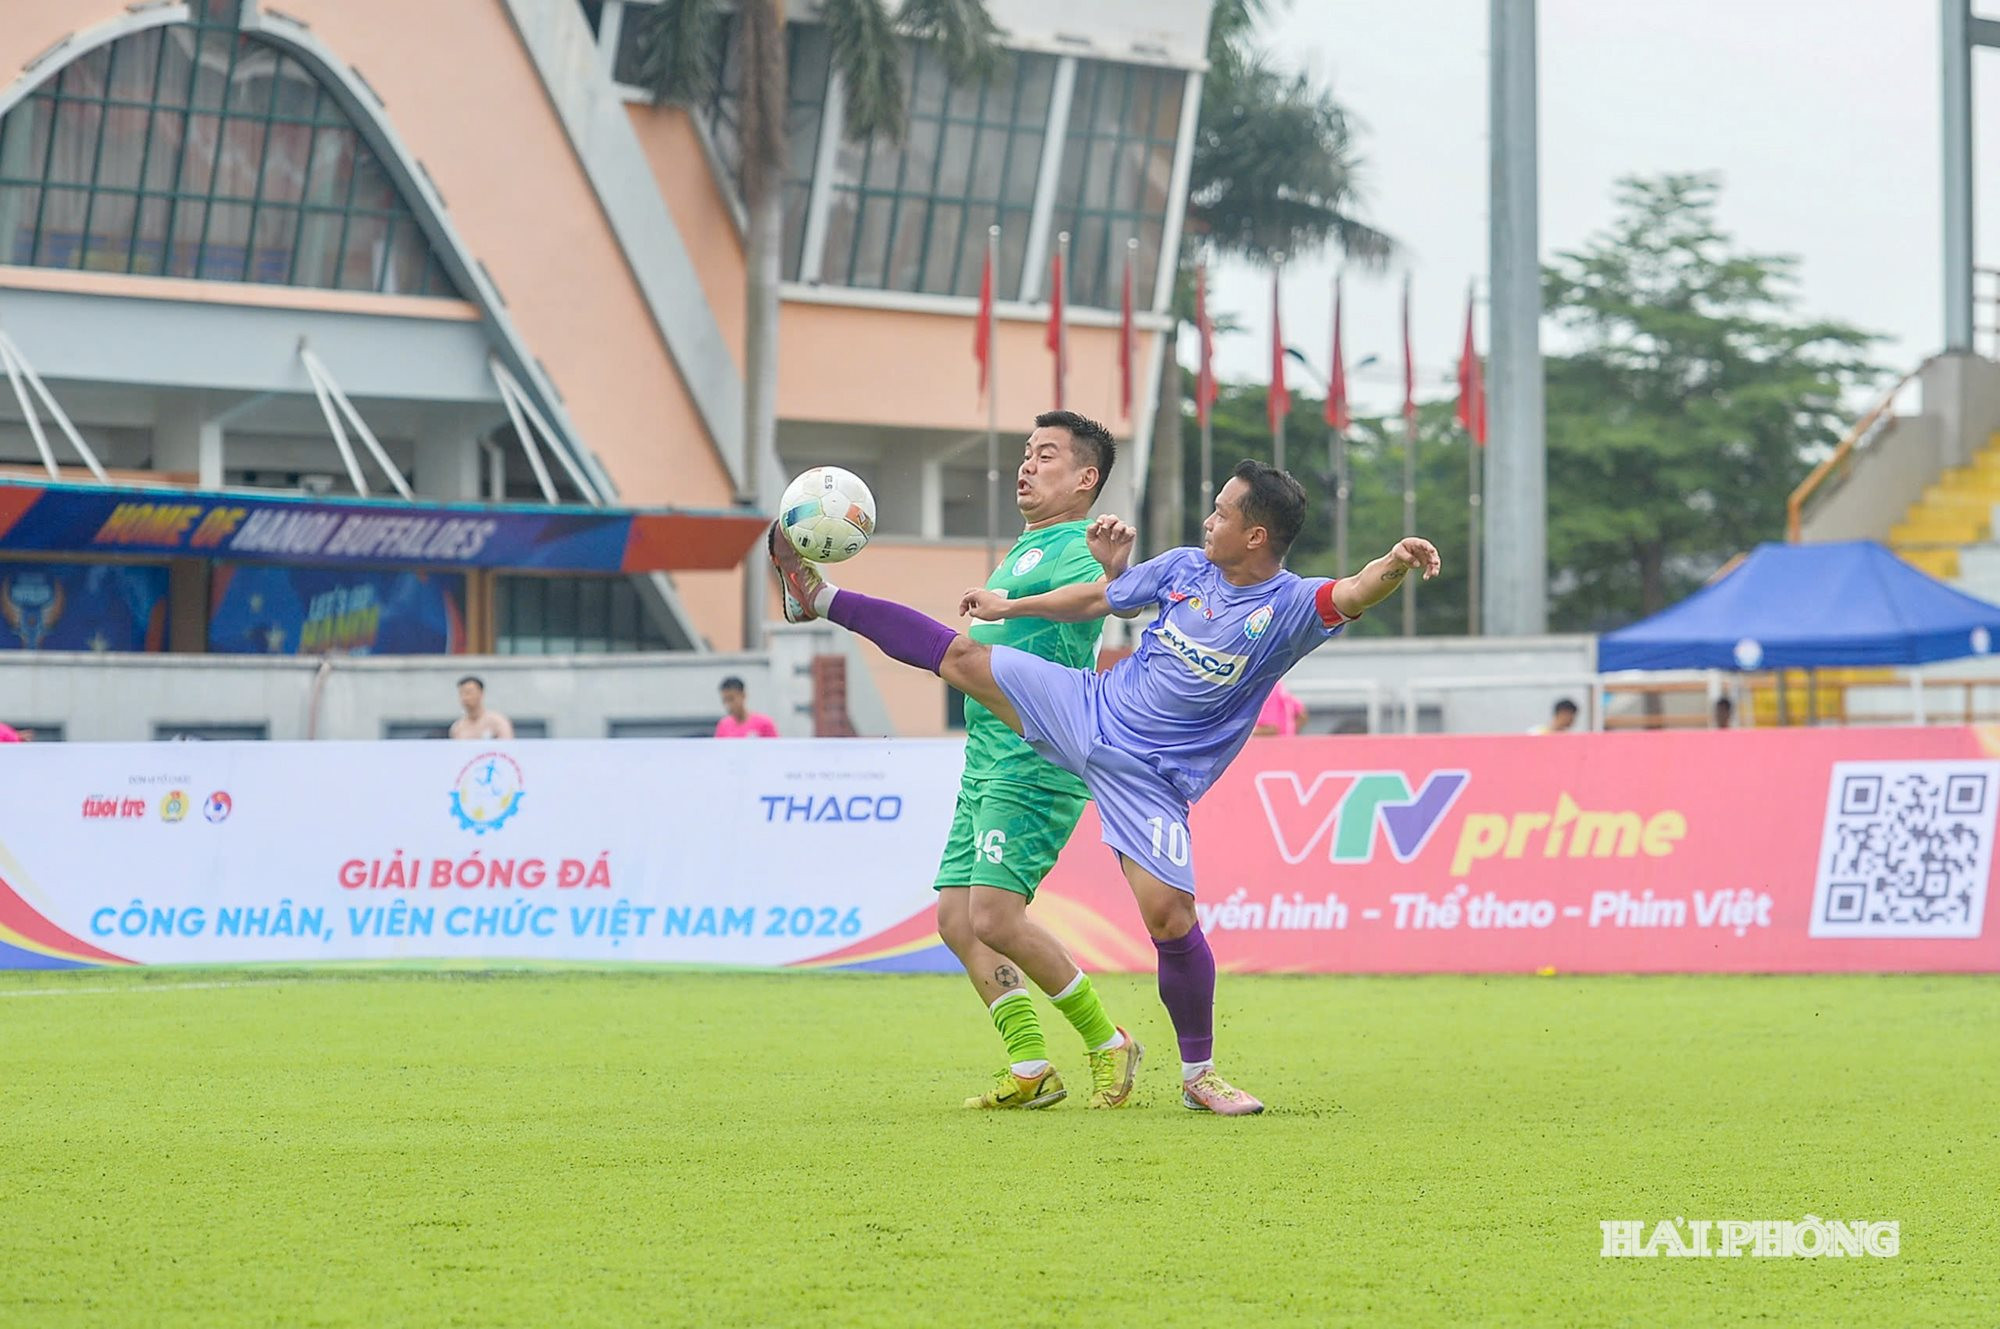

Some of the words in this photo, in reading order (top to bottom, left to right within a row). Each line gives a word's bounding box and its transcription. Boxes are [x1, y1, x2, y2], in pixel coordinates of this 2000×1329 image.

[94, 503, 201, 546] HOME
[190, 506, 247, 547] OF
[229, 508, 341, 554] HANOI
[324, 514, 497, 560] BUFFALOES
[761, 795, 902, 821] THACO
[1255, 769, 1471, 864] VTV
[1147, 816, 1189, 867] 10
[1449, 791, 1688, 876] prime
[338, 849, 421, 889] GIẢI
[430, 850, 547, 889] BÓNG
[557, 850, 612, 889] ĐÁ
[90, 898, 206, 937] CÔNG
[215, 898, 334, 942] NHÂN,
[348, 898, 434, 937] VIÊN
[444, 898, 558, 937] CHỨC
[569, 899, 657, 947] VIỆT
[663, 906, 756, 937] NAM
[763, 905, 863, 938] 2026
[1466, 892, 1556, 929] thao
[1588, 889, 1687, 928] Phim
[1692, 888, 1773, 937] Việt
